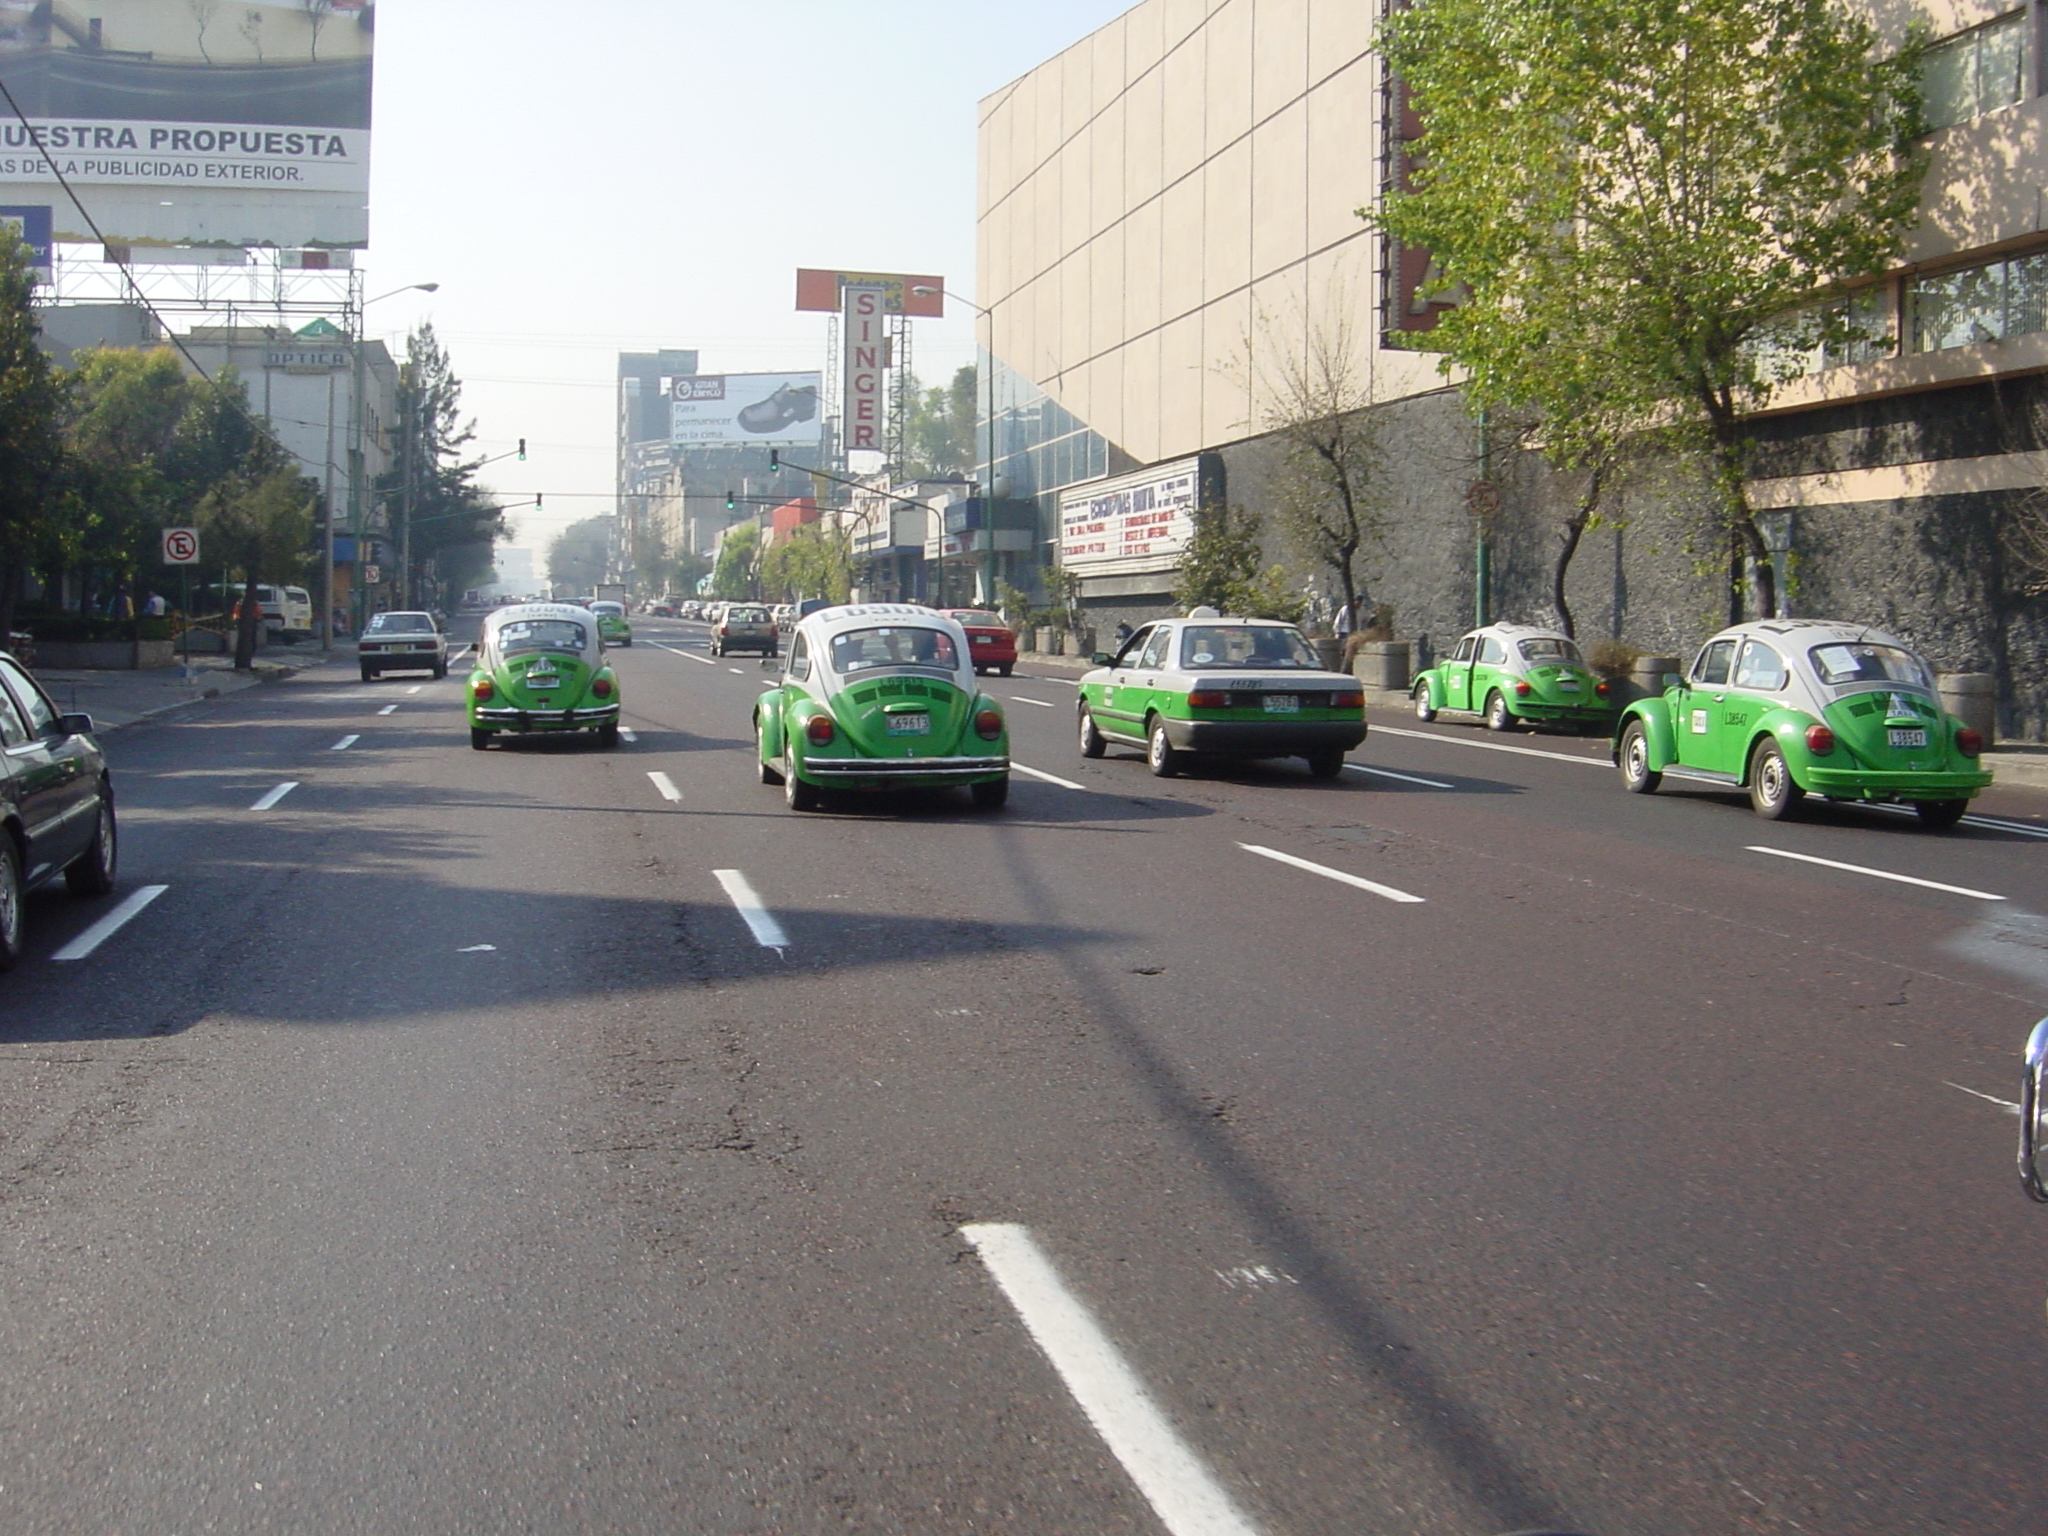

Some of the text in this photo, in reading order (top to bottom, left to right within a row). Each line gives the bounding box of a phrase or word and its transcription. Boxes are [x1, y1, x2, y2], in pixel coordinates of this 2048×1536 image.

[0, 125, 347, 157] UESTRA PROPUESTA
[0, 159, 304, 181] S DE LA PUBLICIDAD EXTERIOR.
[854, 293, 876, 447] SINGER
[675, 404, 696, 413] Para
[675, 417, 732, 428] permanecer
[886, 716, 928, 730] L69613
[1889, 731, 1926, 746] L38547
